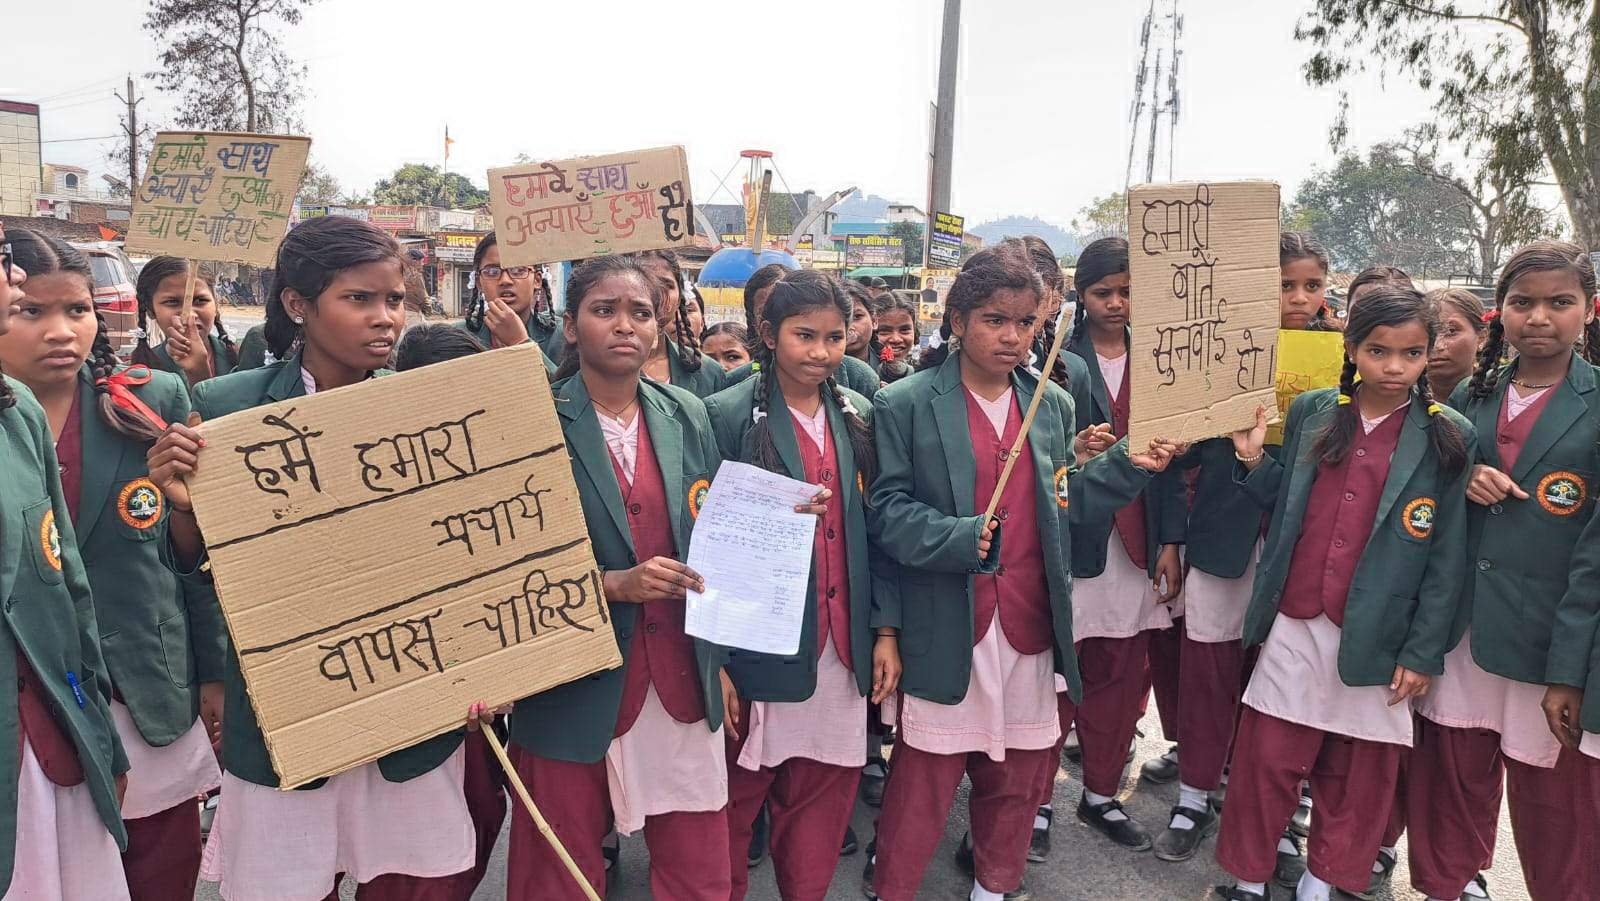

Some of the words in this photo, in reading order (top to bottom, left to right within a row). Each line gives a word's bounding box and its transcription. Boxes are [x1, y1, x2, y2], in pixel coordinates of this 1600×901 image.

[153, 135, 208, 174] हमारे
[217, 142, 280, 177] साथ
[576, 161, 639, 191] साथ
[137, 206, 198, 241] न्याय
[1142, 183, 1214, 256] हमारी
[1152, 298, 1228, 392] सुनवाई
[234, 407, 323, 498] हमें
[354, 409, 485, 492] हमारा
[318, 608, 443, 692] वापस
